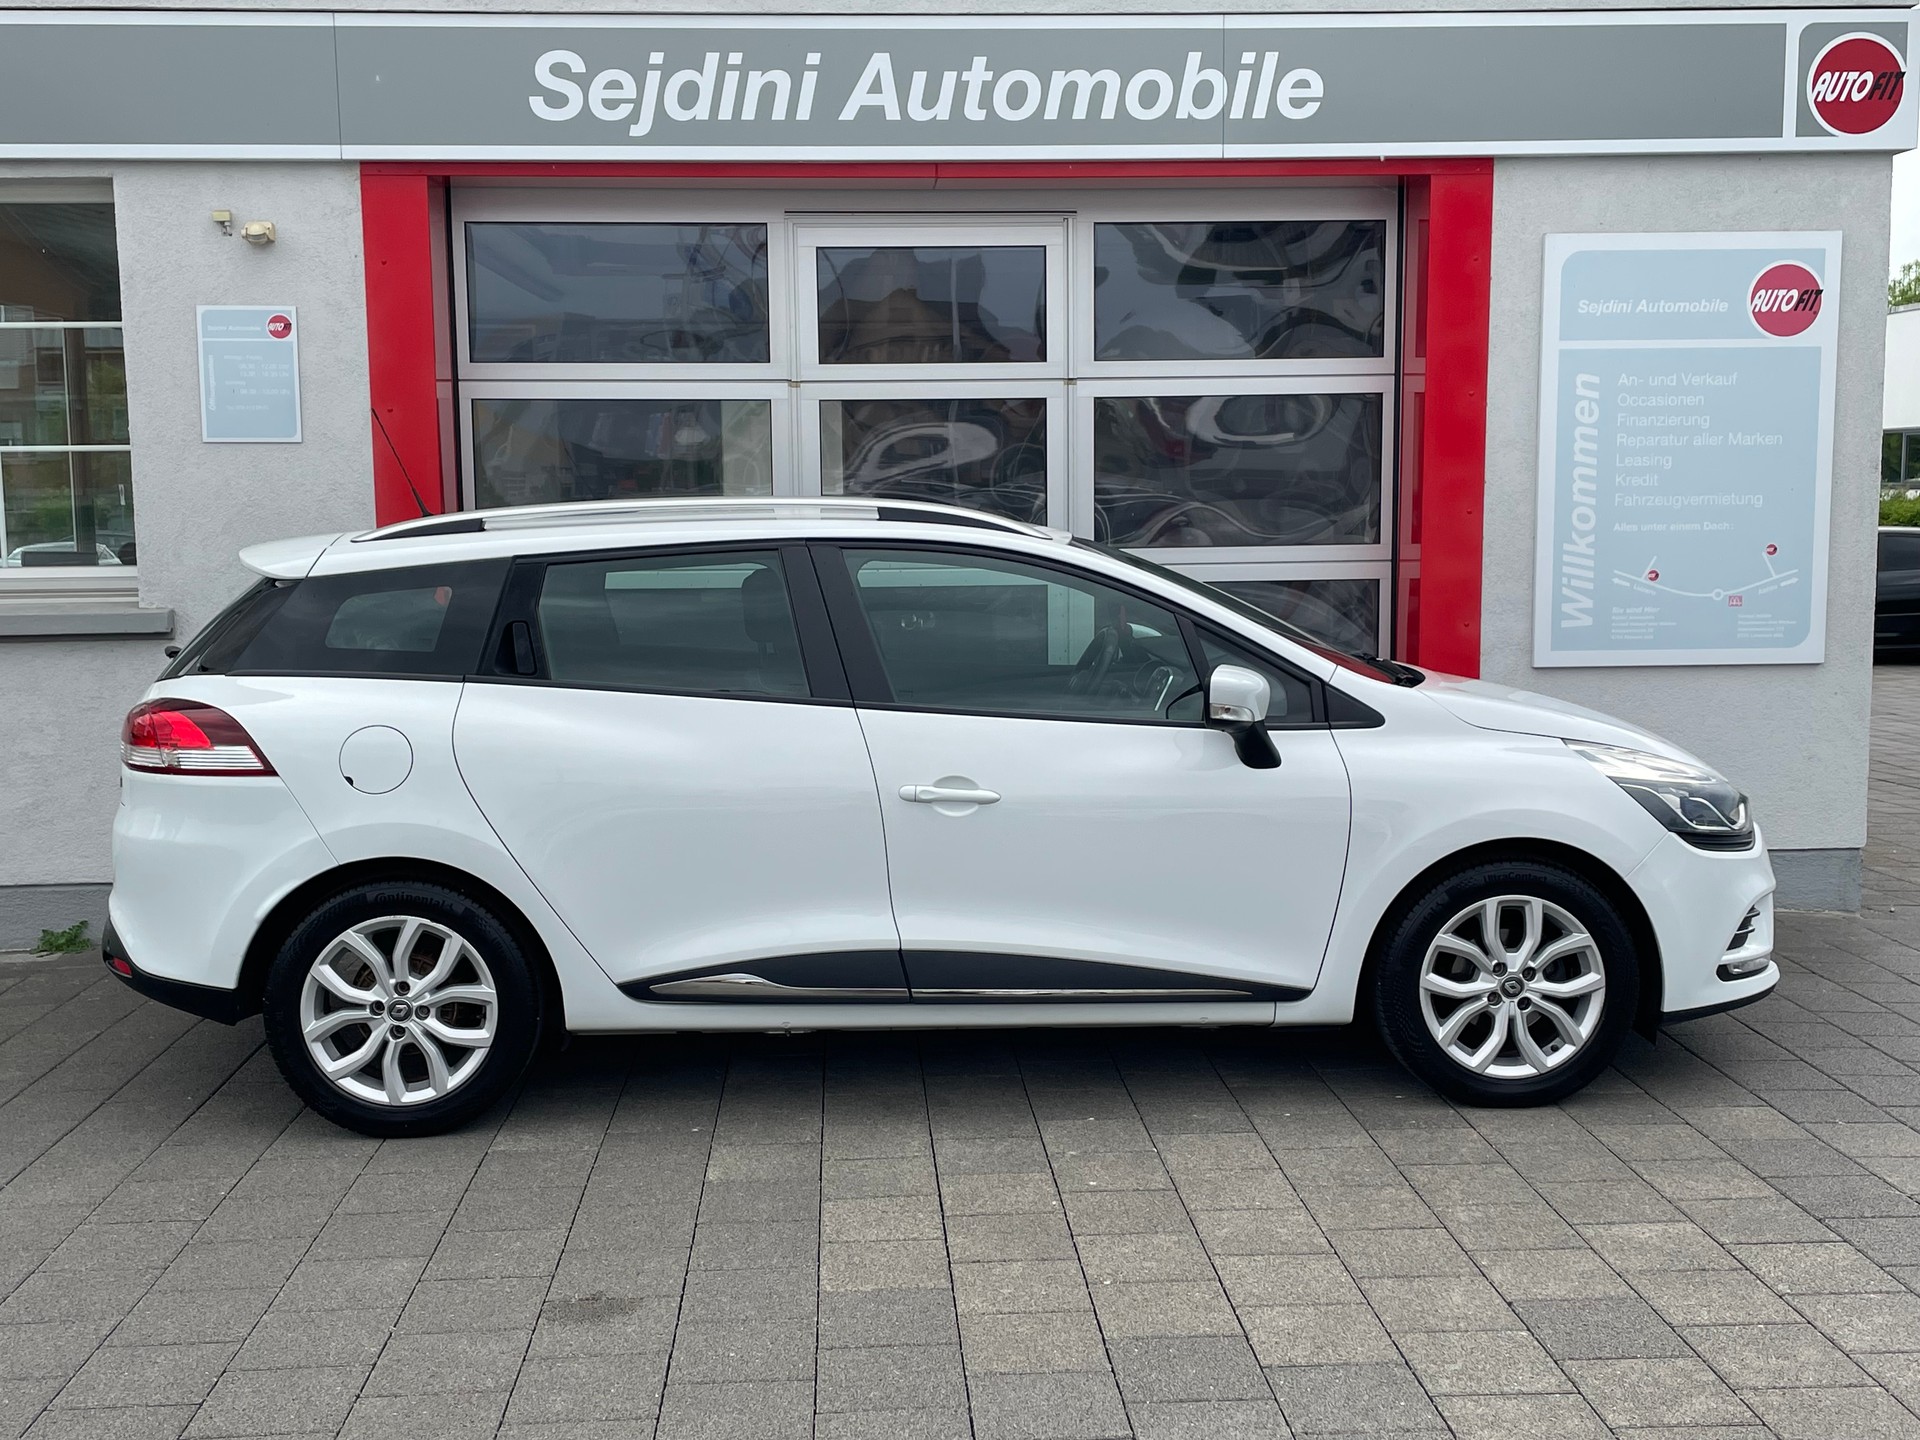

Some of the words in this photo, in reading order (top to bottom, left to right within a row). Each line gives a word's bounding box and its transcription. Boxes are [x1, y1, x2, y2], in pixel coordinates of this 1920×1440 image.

[528, 49, 823, 137] Sejdini
[838, 51, 1325, 122] Automobile
[1812, 70, 1907, 103] AUTOFIT
[1577, 299, 1633, 318] Sejdini
[1636, 298, 1729, 314] Automobile
[1751, 288, 1824, 313] AUTOFIT
[1617, 373, 1645, 387] An-
[1648, 372, 1677, 387] und
[1681, 371, 1738, 386] Verkauf
[1617, 393, 1705, 407] Occasionen
[1616, 412, 1711, 429] Finanzierung
[1616, 433, 1689, 450] Reparatur
[1692, 432, 1723, 446] aller
[1728, 432, 1783, 446] Marken
[1615, 453, 1673, 469] Leasing
[1614, 473, 1660, 487] Kredit
[1560, 372, 1601, 629] Willkommen
[1614, 492, 1764, 509] Fahrzeugvermietung
[1613, 522, 1639, 532] Alles
[1641, 522, 1668, 532] unter
[1670, 521, 1701, 531] einem
[375, 891, 446, 907] Continental
